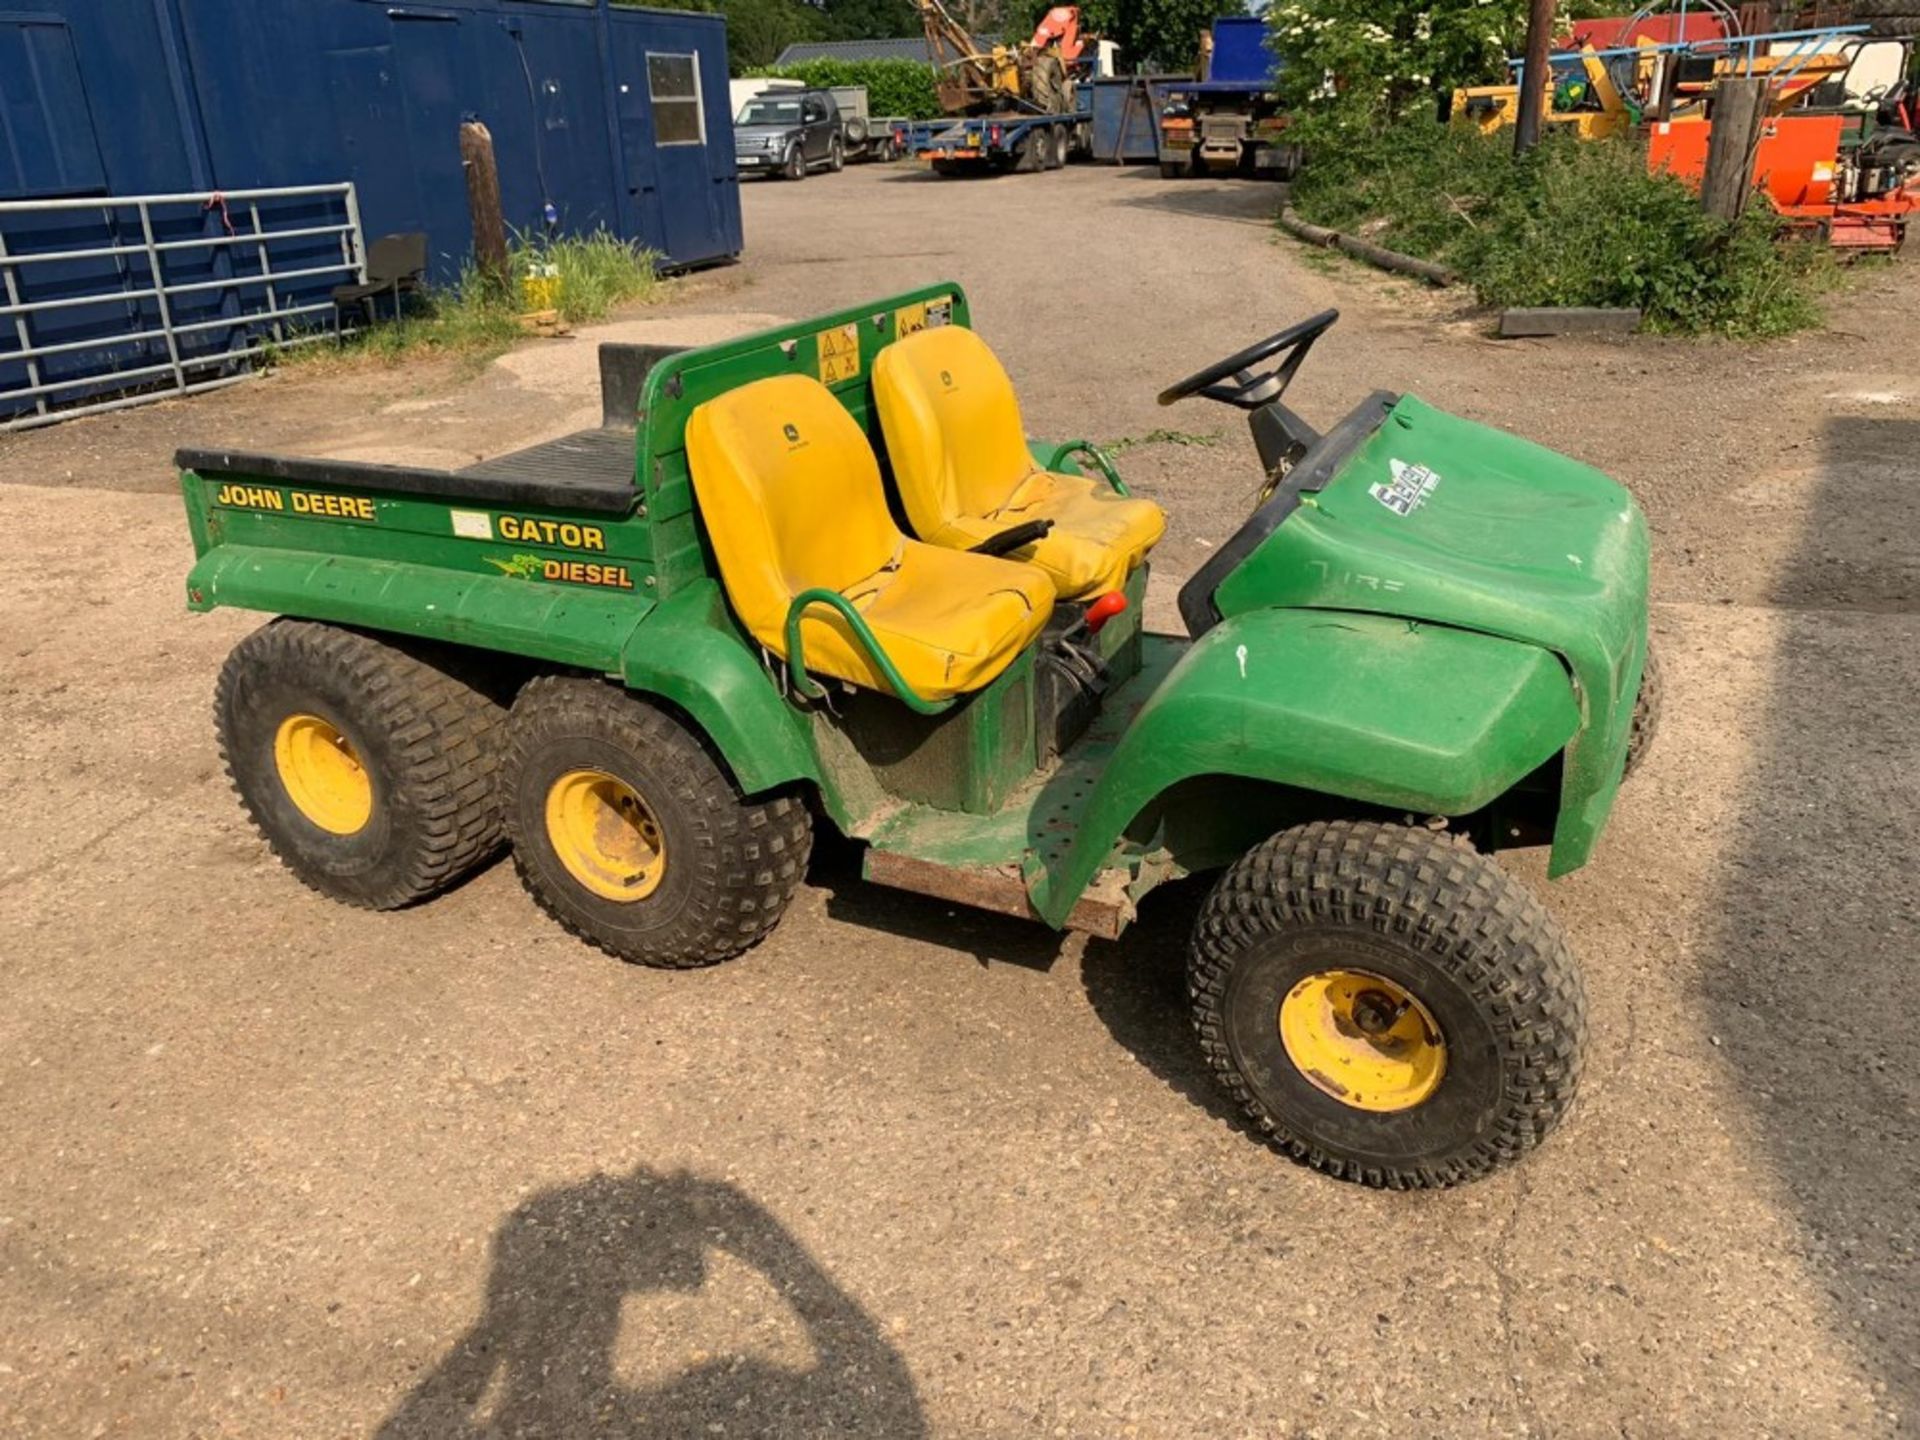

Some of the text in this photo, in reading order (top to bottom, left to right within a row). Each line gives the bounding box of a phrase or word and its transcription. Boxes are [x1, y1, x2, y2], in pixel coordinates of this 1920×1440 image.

[217, 484, 375, 520] JOHN DEERE
[498, 515, 605, 550] GATOR
[543, 559, 633, 588] DIESEL
